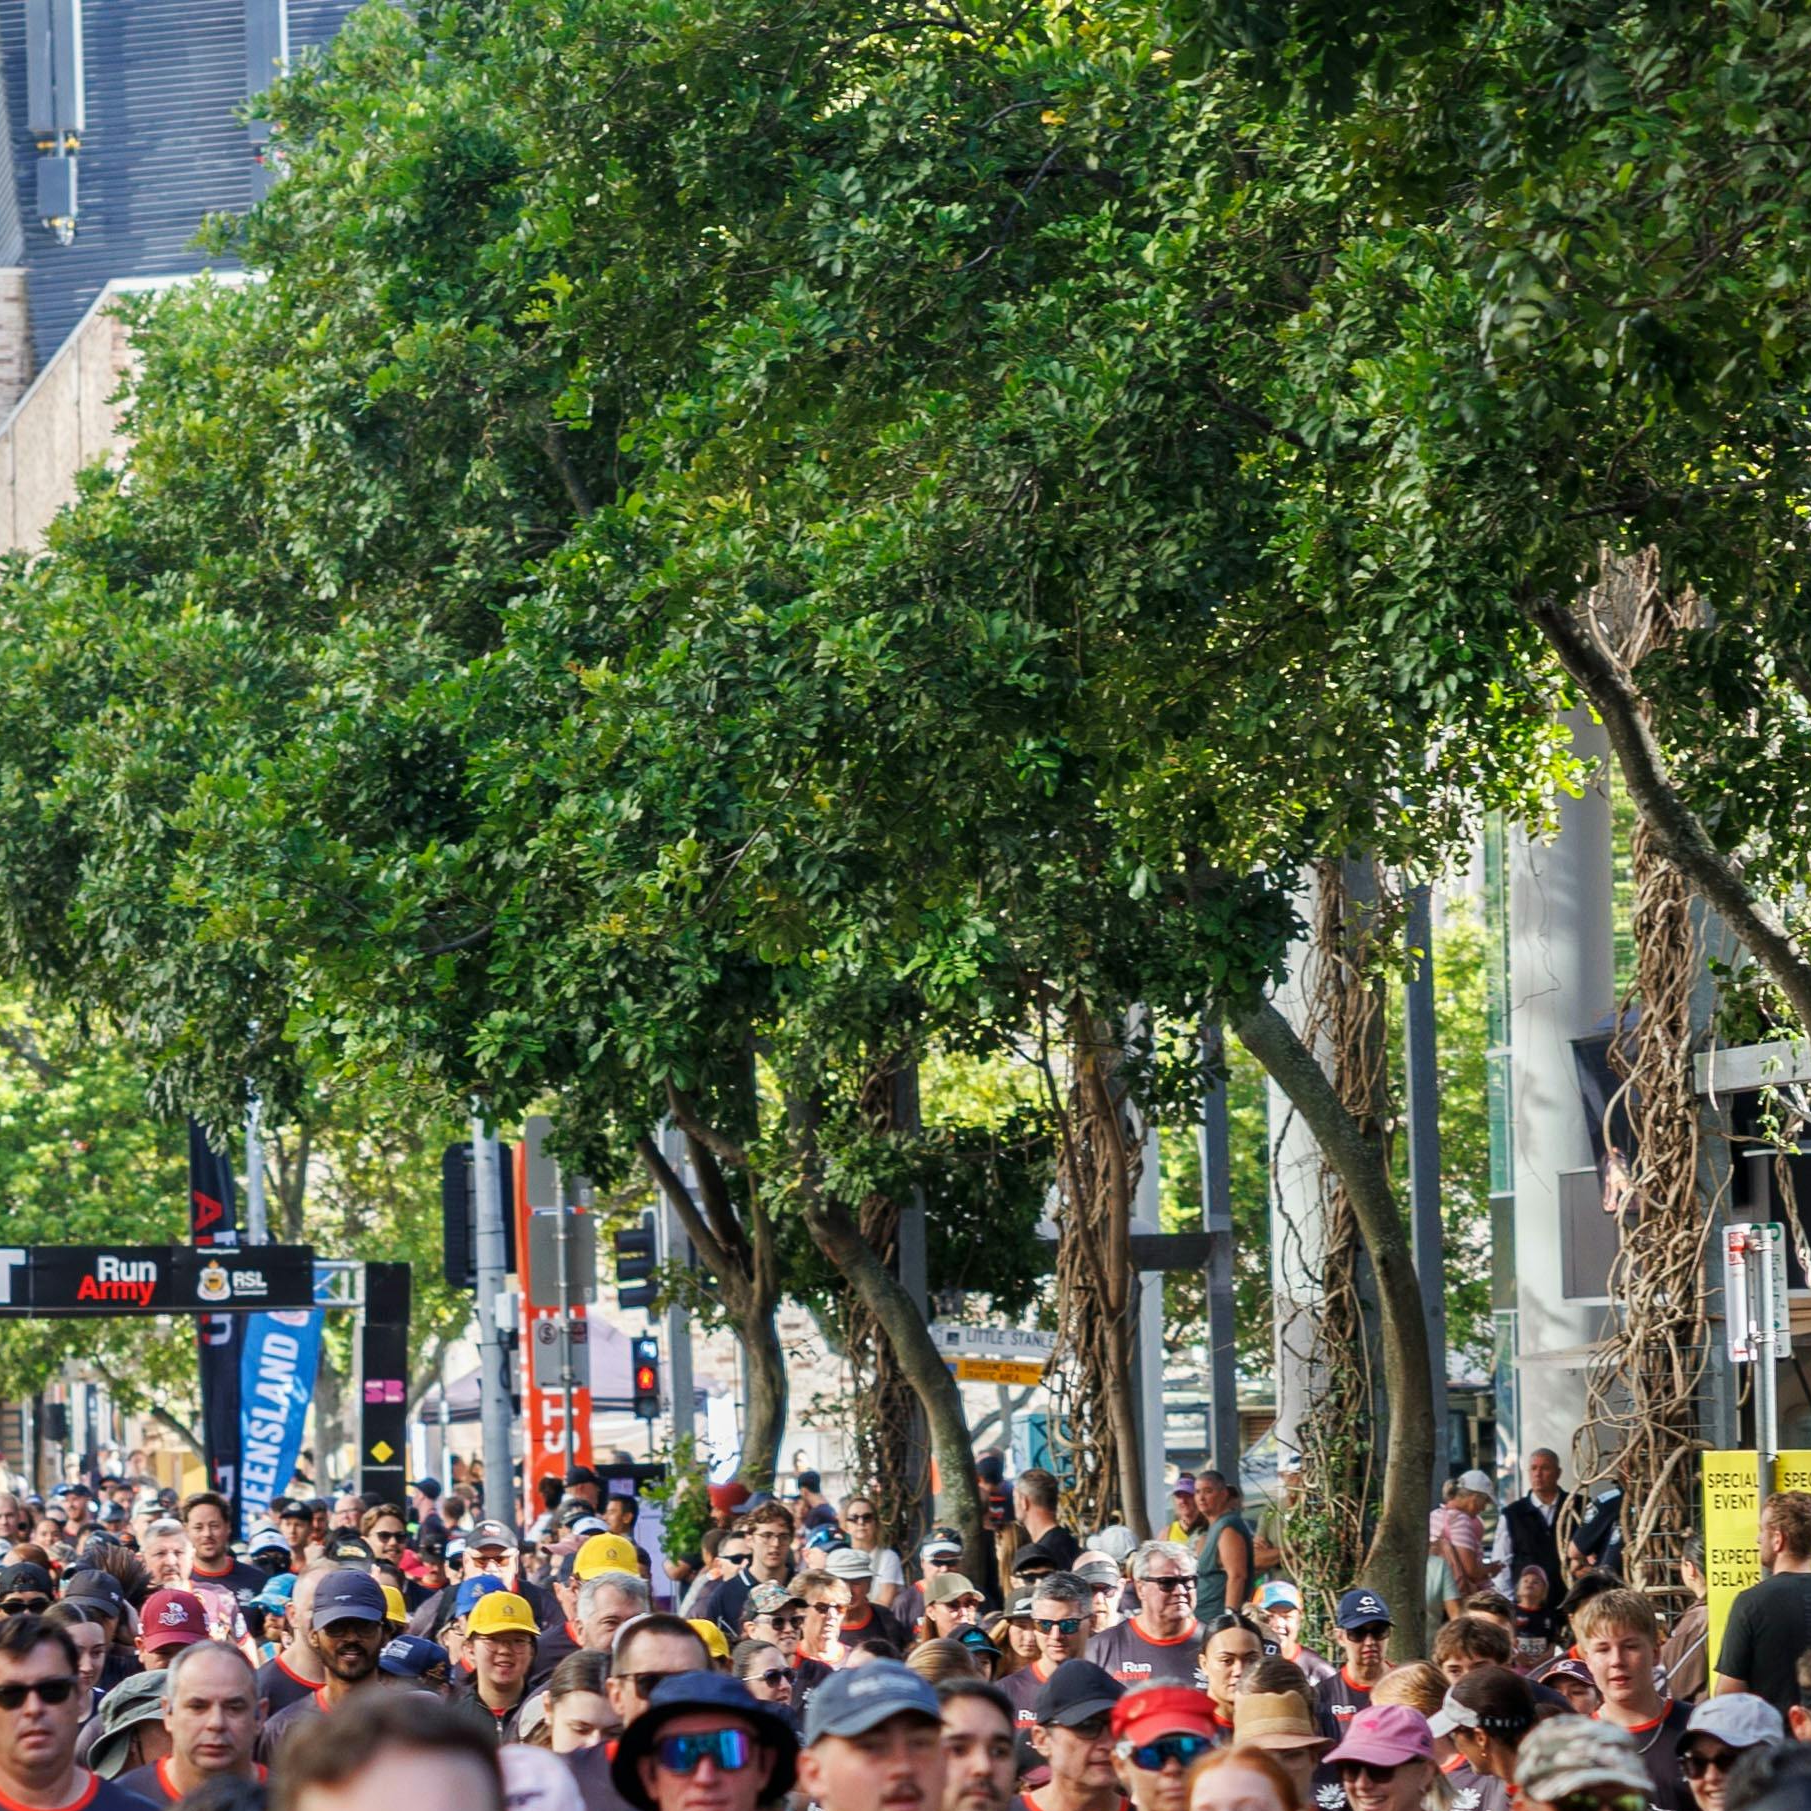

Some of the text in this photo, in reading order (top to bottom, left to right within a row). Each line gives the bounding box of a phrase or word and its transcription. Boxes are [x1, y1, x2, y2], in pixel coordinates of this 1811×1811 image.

[97, 1256, 157, 1282] Run
[232, 1271, 267, 1287] RSL
[76, 1274, 157, 1307] Army
[966, 1330, 1055, 1348] LITTLE STANLE
[1708, 1473, 1760, 1489] SPECIAL
[1714, 1494, 1755, 1510] EVENT
[1712, 1549, 1759, 1565] EXPECT
[1712, 1571, 1761, 1587] DELAYS
[1122, 1661, 1151, 1673] Run
